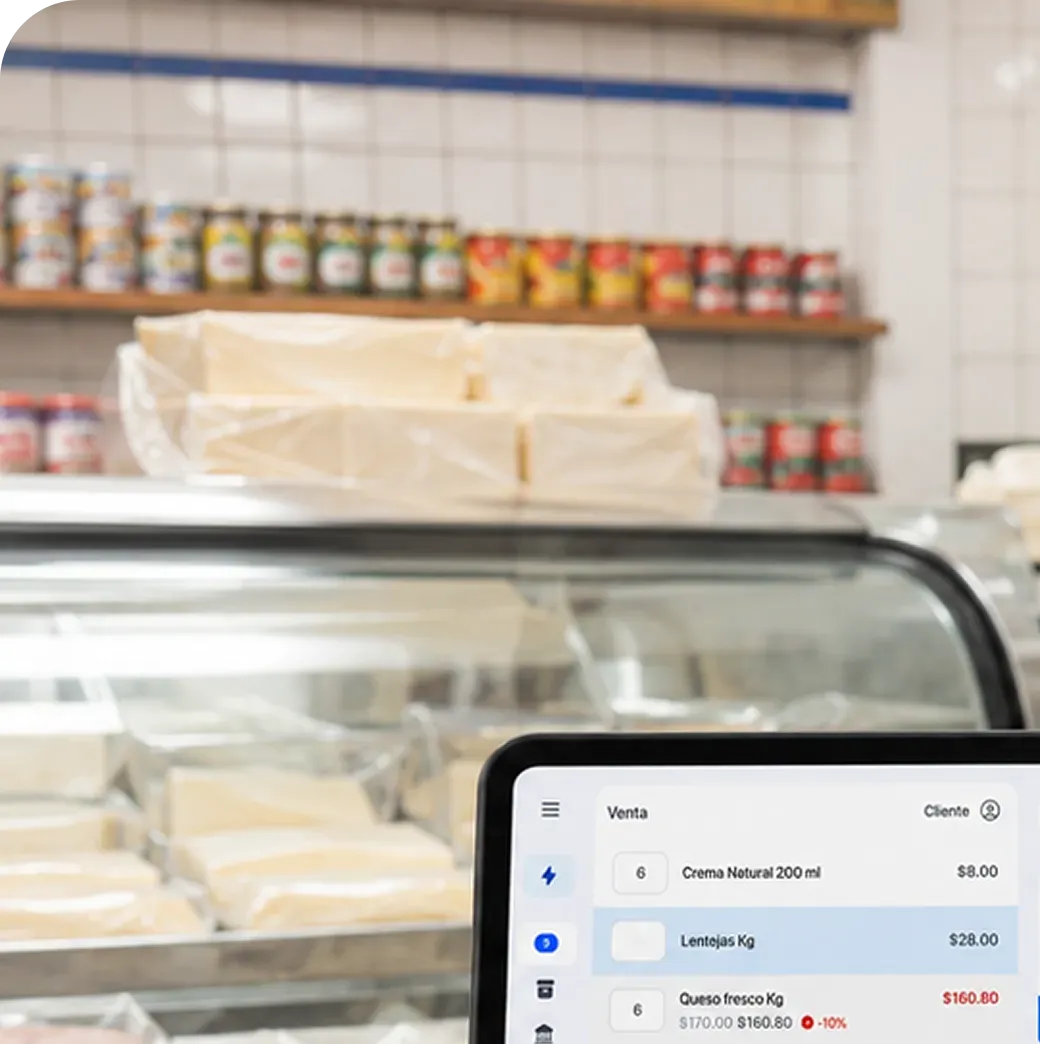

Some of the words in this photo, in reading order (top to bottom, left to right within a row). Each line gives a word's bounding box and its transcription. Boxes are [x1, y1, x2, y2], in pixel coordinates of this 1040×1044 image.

[606, 805, 649, 820] Venta
[923, 803, 970, 819] Cliente
[635, 865, 647, 880] 6
[681, 865, 725, 880] Crema
[775, 865, 803, 880] 200
[804, 865, 822, 879] ml
[957, 864, 999, 879] $8.00
[680, 934, 736, 950] Lentejas
[737, 934, 756, 950] Kg
[948, 932, 999, 947] $28.00
[679, 991, 722, 1006] Queso
[723, 992, 765, 1006] fresco
[766, 992, 784, 1009] Kg
[942, 990, 1000, 1006] $160.80
[632, 1002, 643, 1017] 6
[678, 1015, 734, 1030] $170.00
[737, 1015, 793, 1030] $160.80
[817, 1016, 848, 1030] -10%
